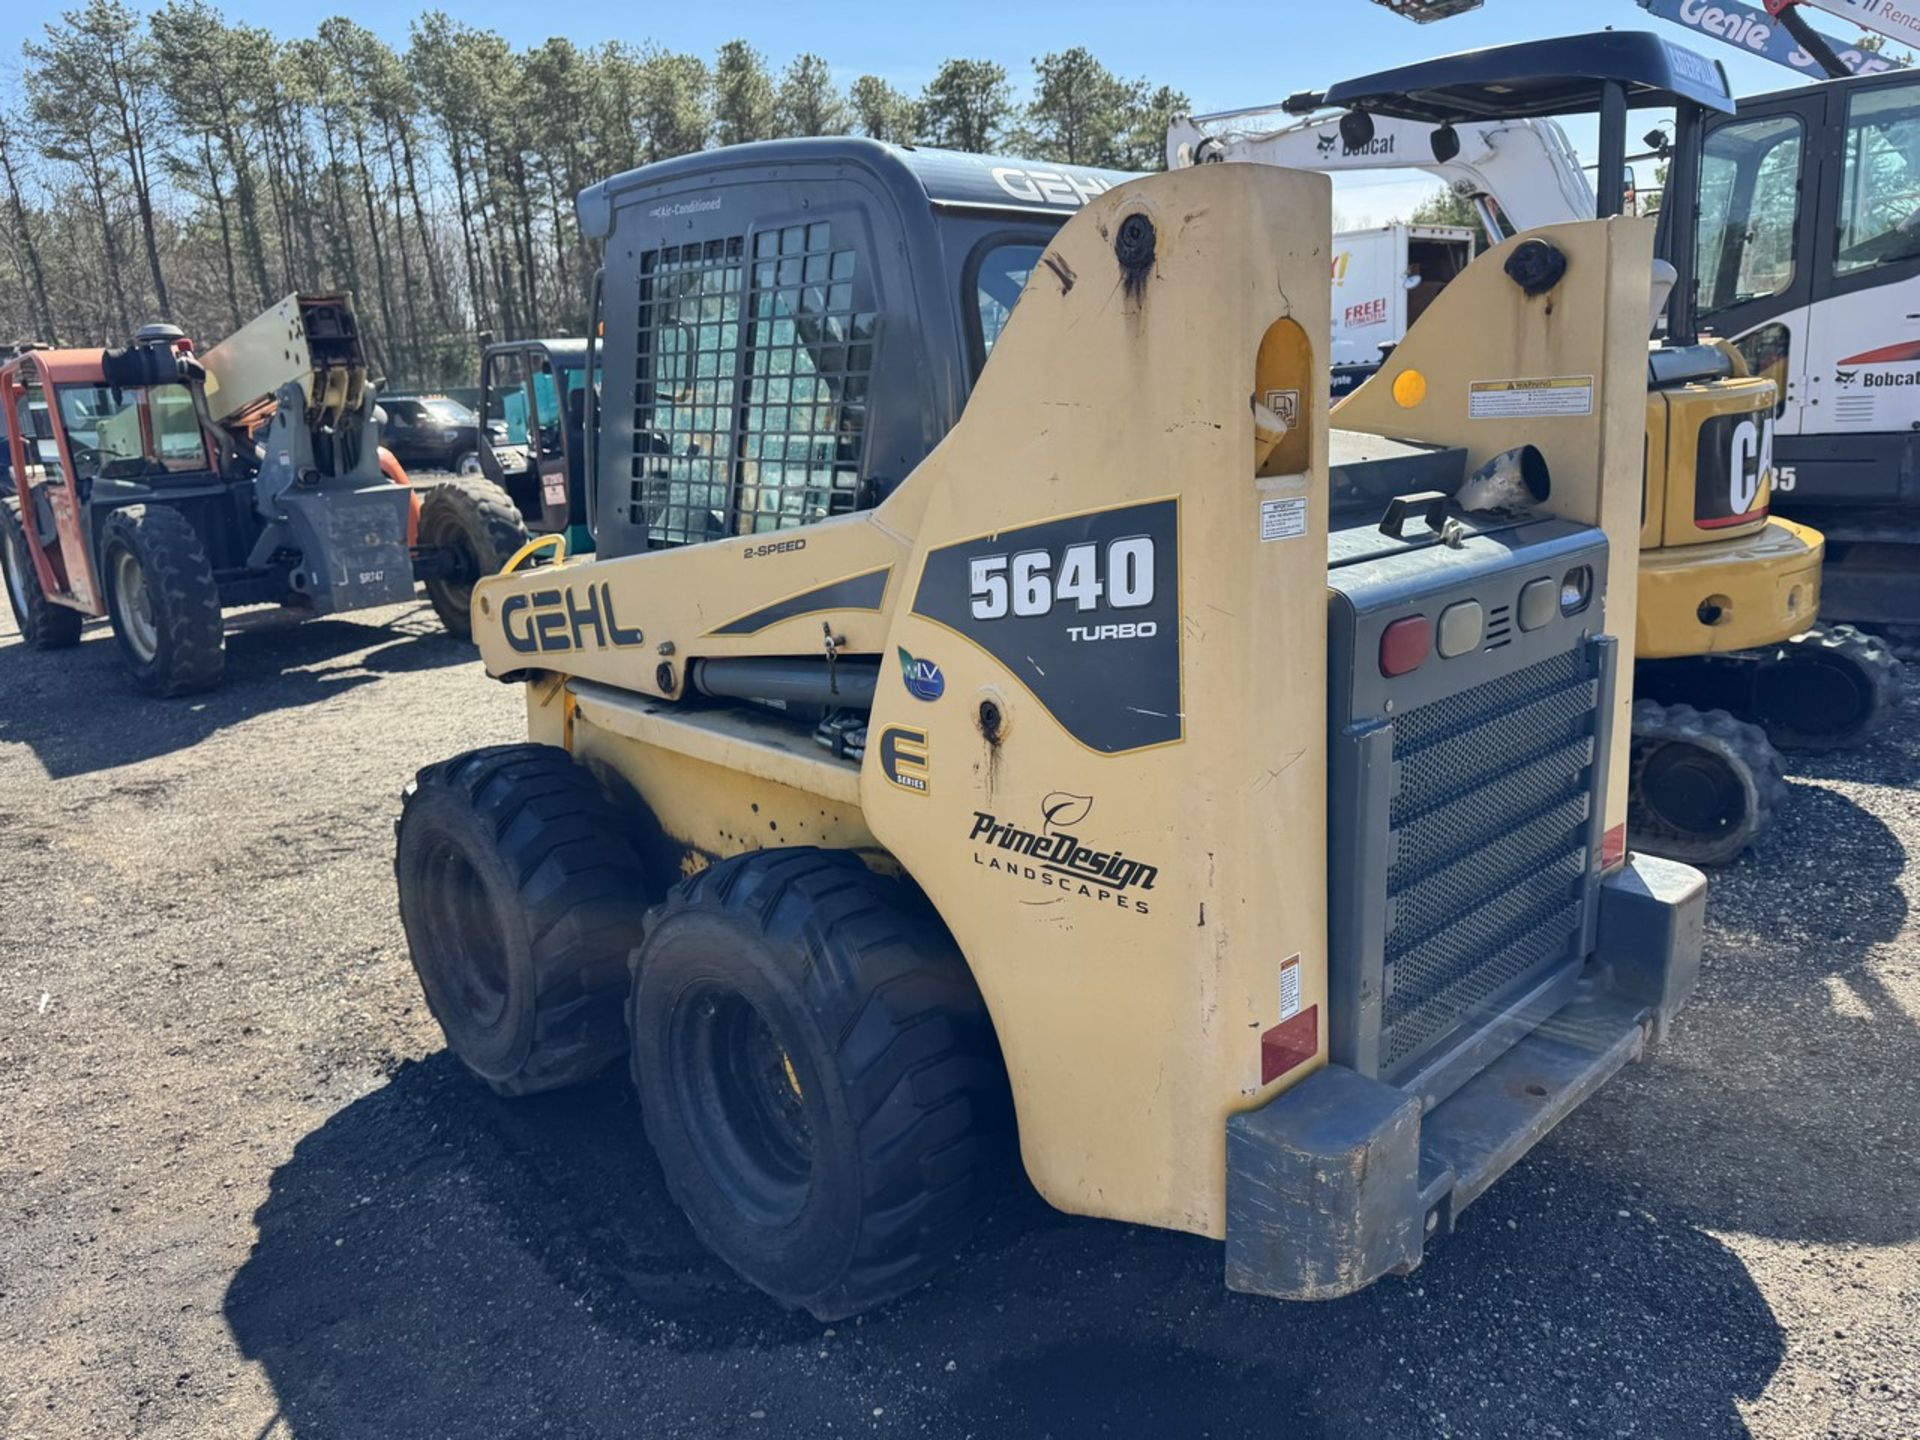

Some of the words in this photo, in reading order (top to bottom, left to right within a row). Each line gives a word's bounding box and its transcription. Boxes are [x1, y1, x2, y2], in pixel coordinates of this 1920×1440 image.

[1680, 0, 1771, 49] Genie
[1344, 297, 1386, 320] FREE!
[1863, 371, 1920, 387] Bobcat
[744, 539, 806, 559] 2-SPEED
[970, 534, 1155, 619] 5640
[502, 581, 644, 653] GEHL
[1066, 622, 1157, 642] TURBO
[896, 774, 925, 789] SERIES
[974, 852, 1150, 914] LANDSCAPES
